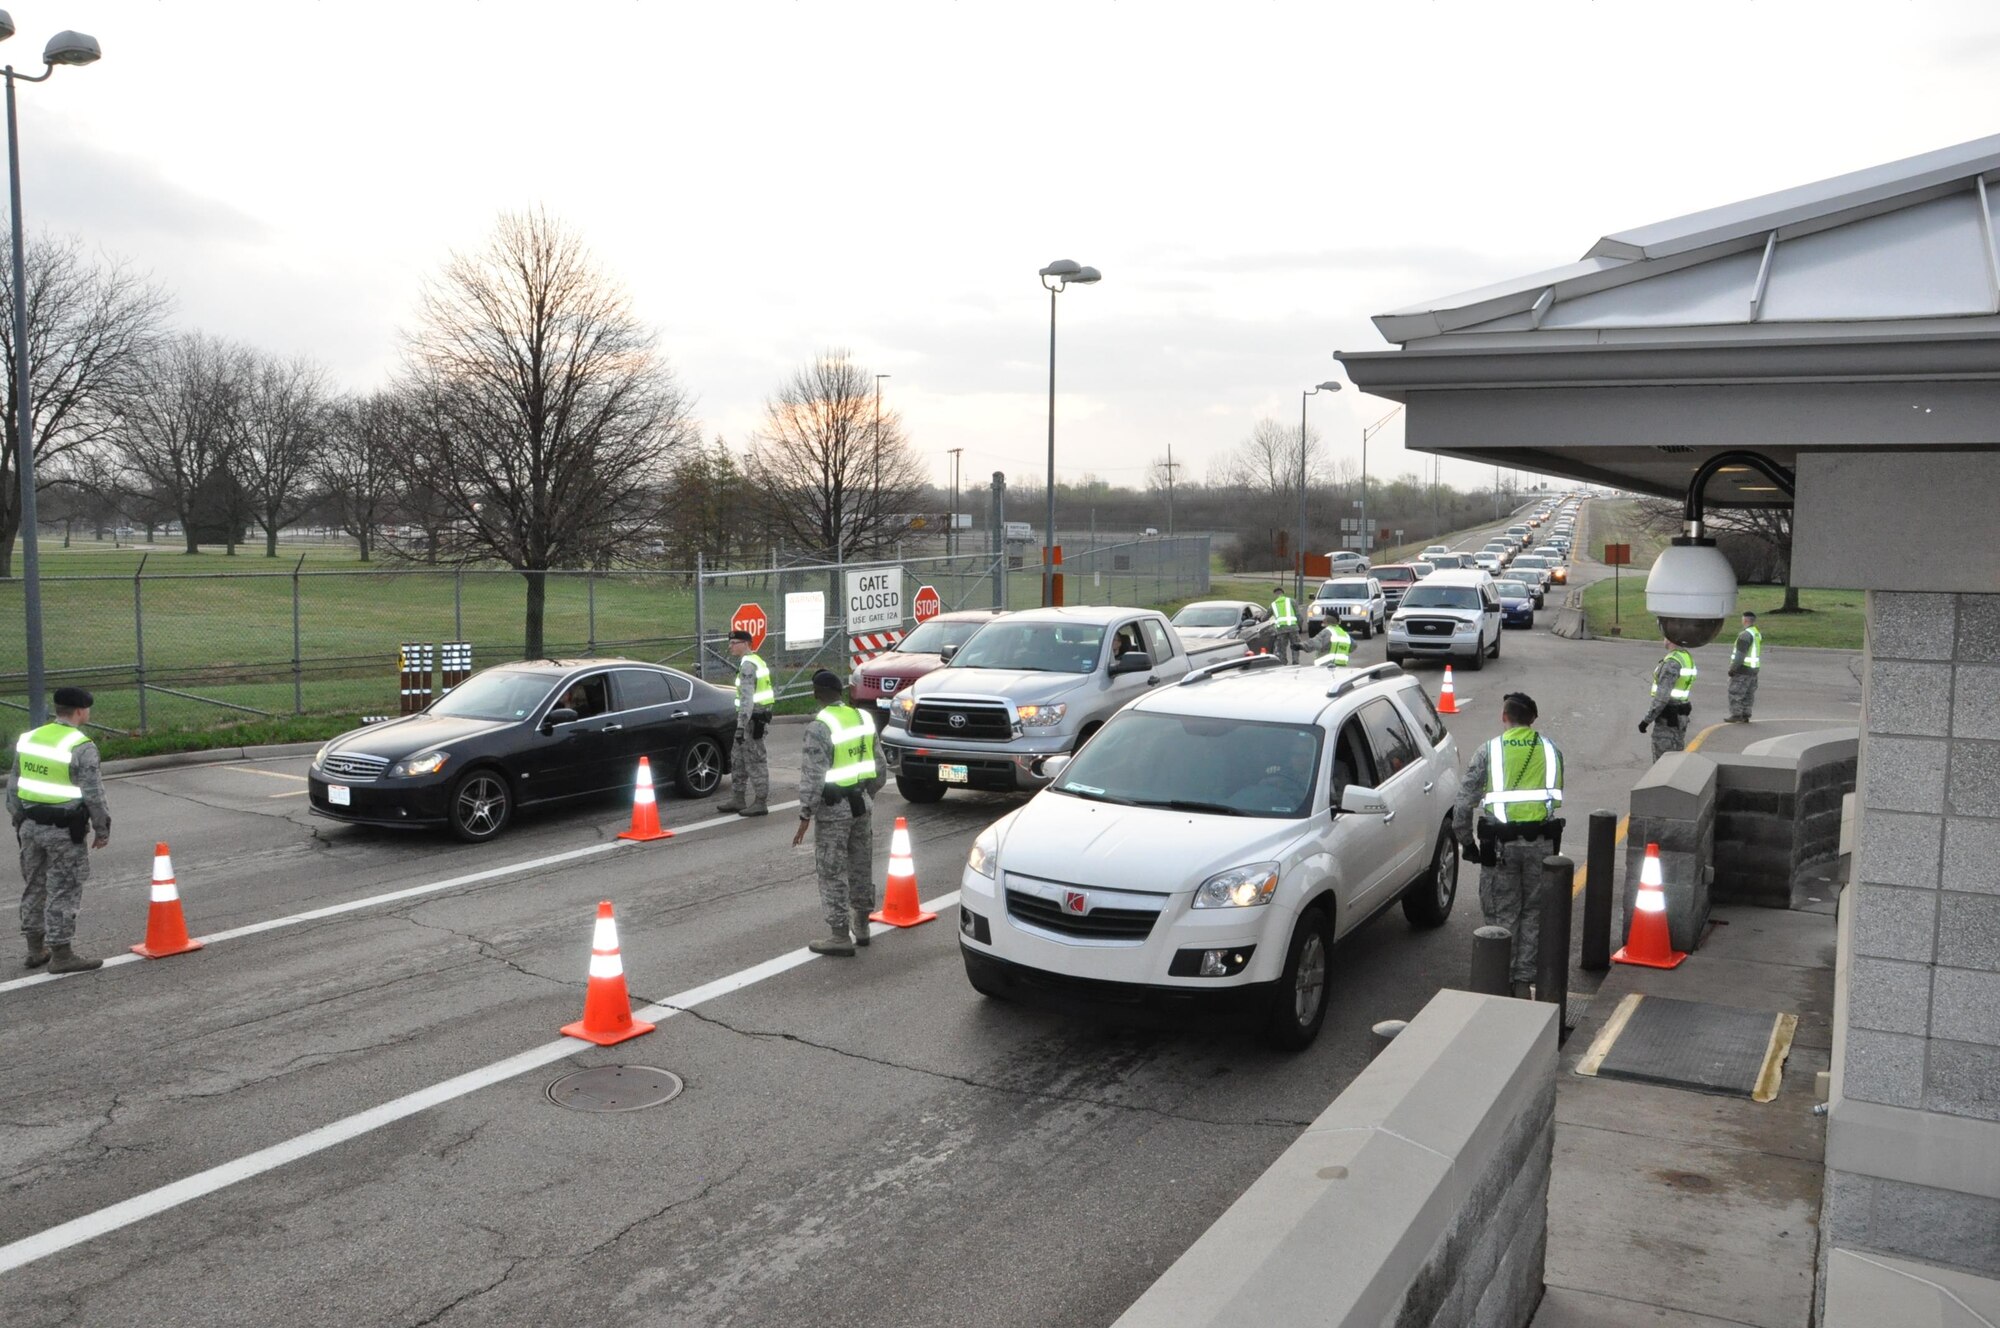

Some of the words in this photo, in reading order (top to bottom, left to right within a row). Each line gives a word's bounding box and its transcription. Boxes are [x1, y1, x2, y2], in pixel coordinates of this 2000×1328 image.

[859, 575, 889, 592] GATE
[850, 592, 899, 611] CLOSED
[916, 601, 938, 616] STOP
[852, 615, 867, 624] USE
[868, 613, 885, 623] GATE
[886, 611, 898, 620] 12A
[734, 618, 765, 636] STOP
[848, 744, 867, 757] POLE
[1503, 739, 1540, 747] POLIC
[24, 761, 49, 776] POLICE
